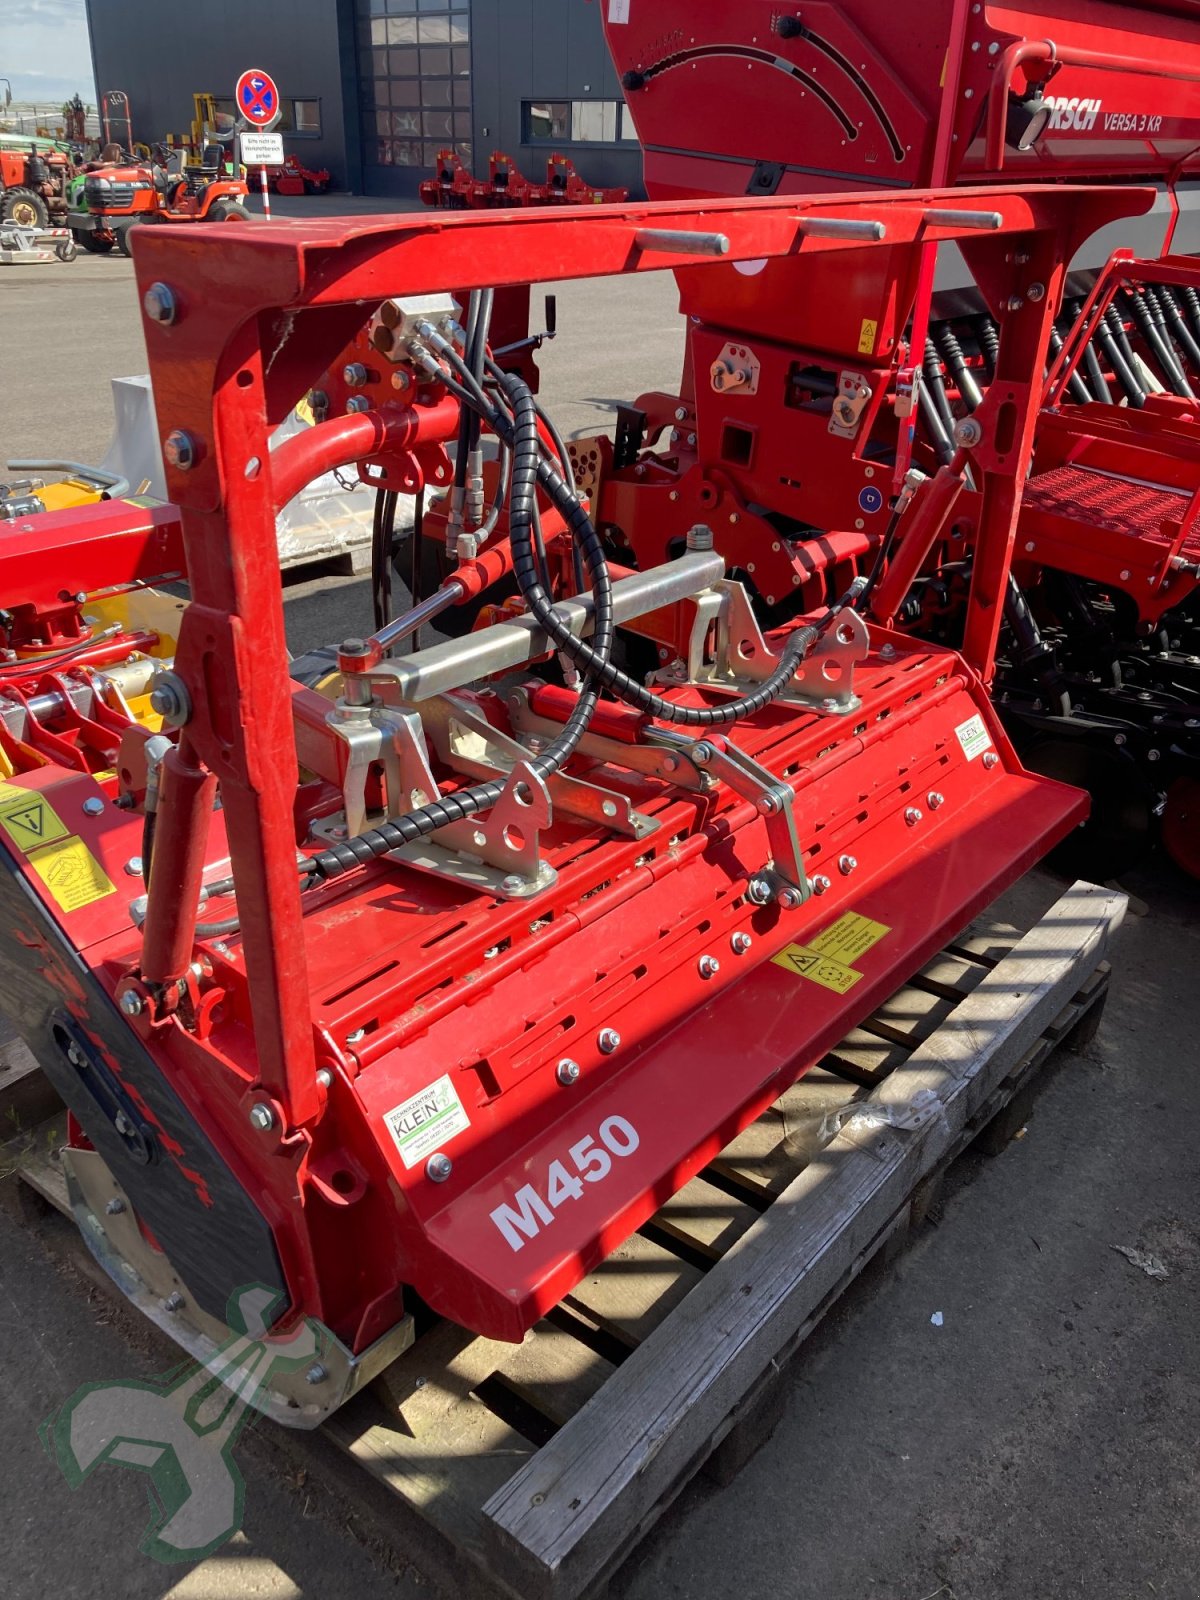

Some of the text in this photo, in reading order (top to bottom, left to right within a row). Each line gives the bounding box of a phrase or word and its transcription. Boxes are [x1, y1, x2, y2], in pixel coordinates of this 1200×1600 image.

[1041, 95, 1102, 131] ORSCH
[1103, 113, 1162, 132] VERSA 3 KR
[839, 975, 852, 986] STOP
[390, 1090, 436, 1122] TECHNIKZENTRUM
[393, 1099, 439, 1139] KLEIN
[489, 1115, 640, 1252] M450
